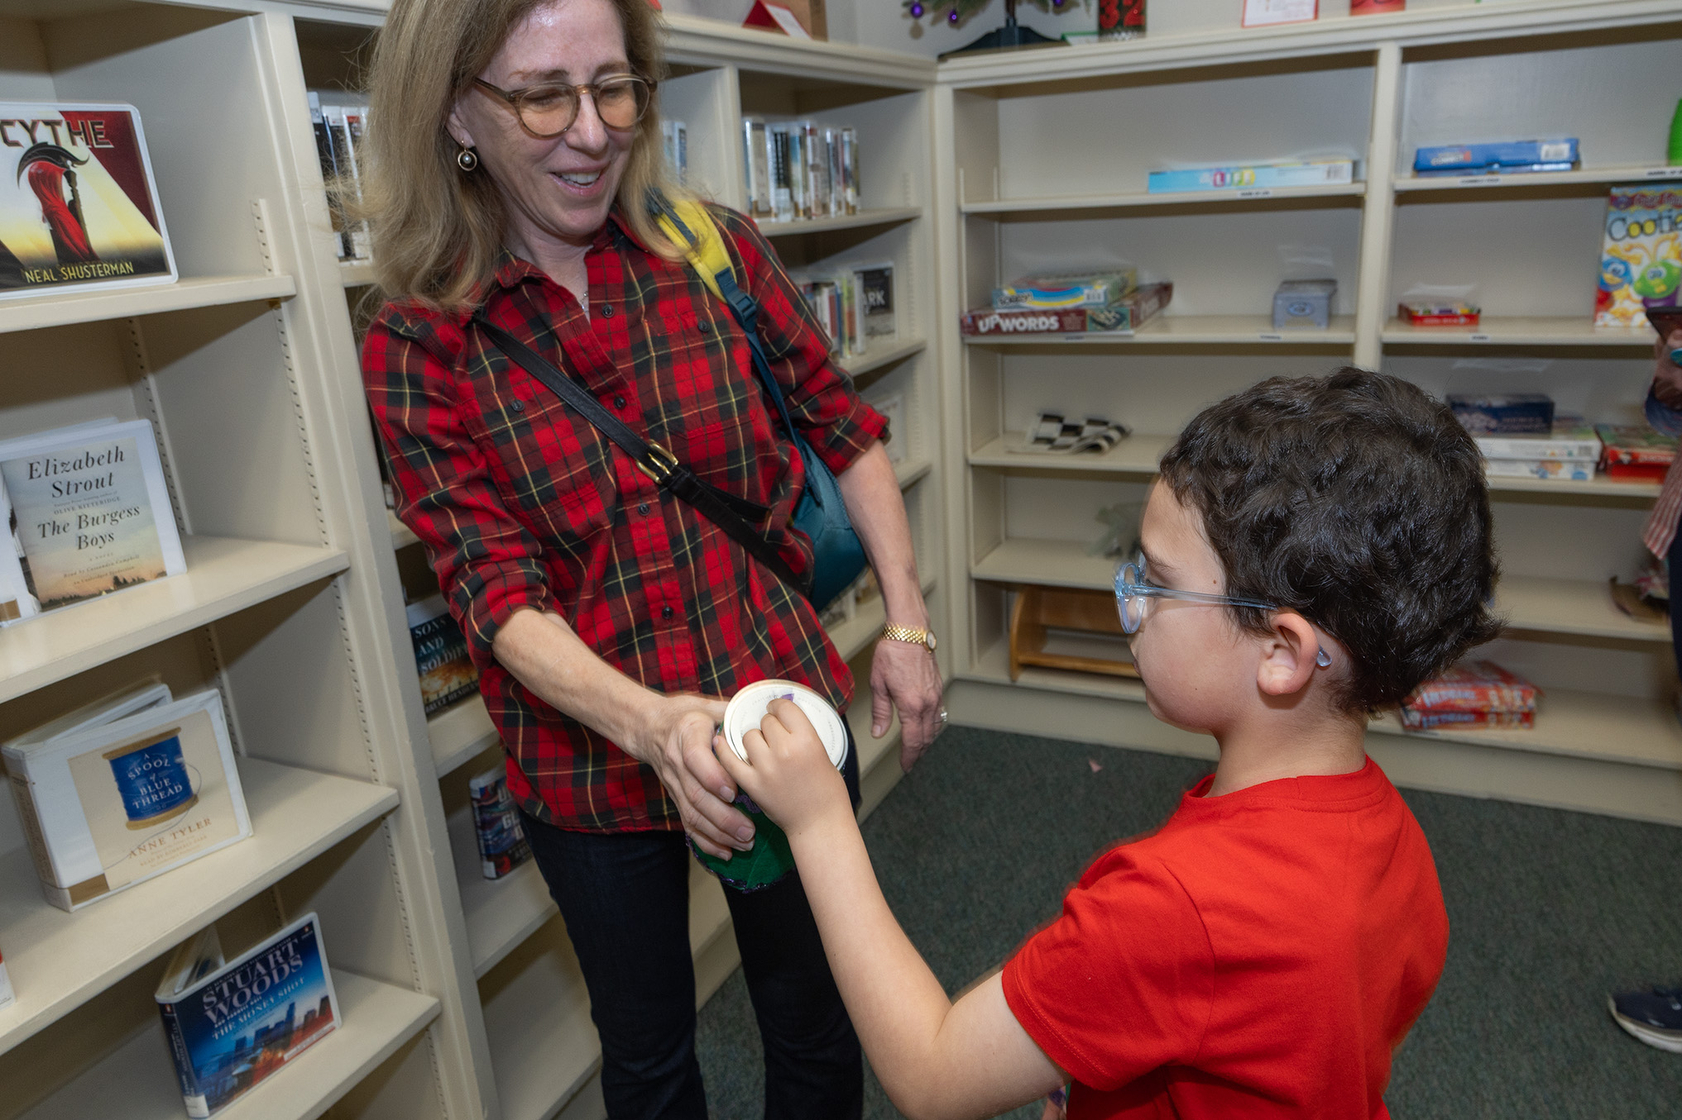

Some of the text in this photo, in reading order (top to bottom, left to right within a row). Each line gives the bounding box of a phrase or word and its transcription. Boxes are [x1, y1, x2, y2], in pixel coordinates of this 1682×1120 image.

[25, 261, 134, 283] NEAL SHUSTERMAN
[978, 314, 1060, 333] UPWORDS
[28, 446, 125, 480] Elizabeth
[51, 472, 115, 498] Strout
[37, 506, 140, 539] The Burgess
[77, 532, 115, 550] Boys
[417, 636, 444, 657] AND
[127, 759, 171, 780] SPOOL
[132, 784, 183, 809] THREAD
[140, 777, 171, 796] BLUE
[128, 837, 166, 859] ANNE
[170, 817, 212, 840] TYLER
[203, 938, 299, 1010] STUART
[205, 954, 303, 1024] WOODS
[212, 1021, 236, 1040] THE
[238, 996, 275, 1023] MONEY
[278, 976, 304, 997] SHOT
